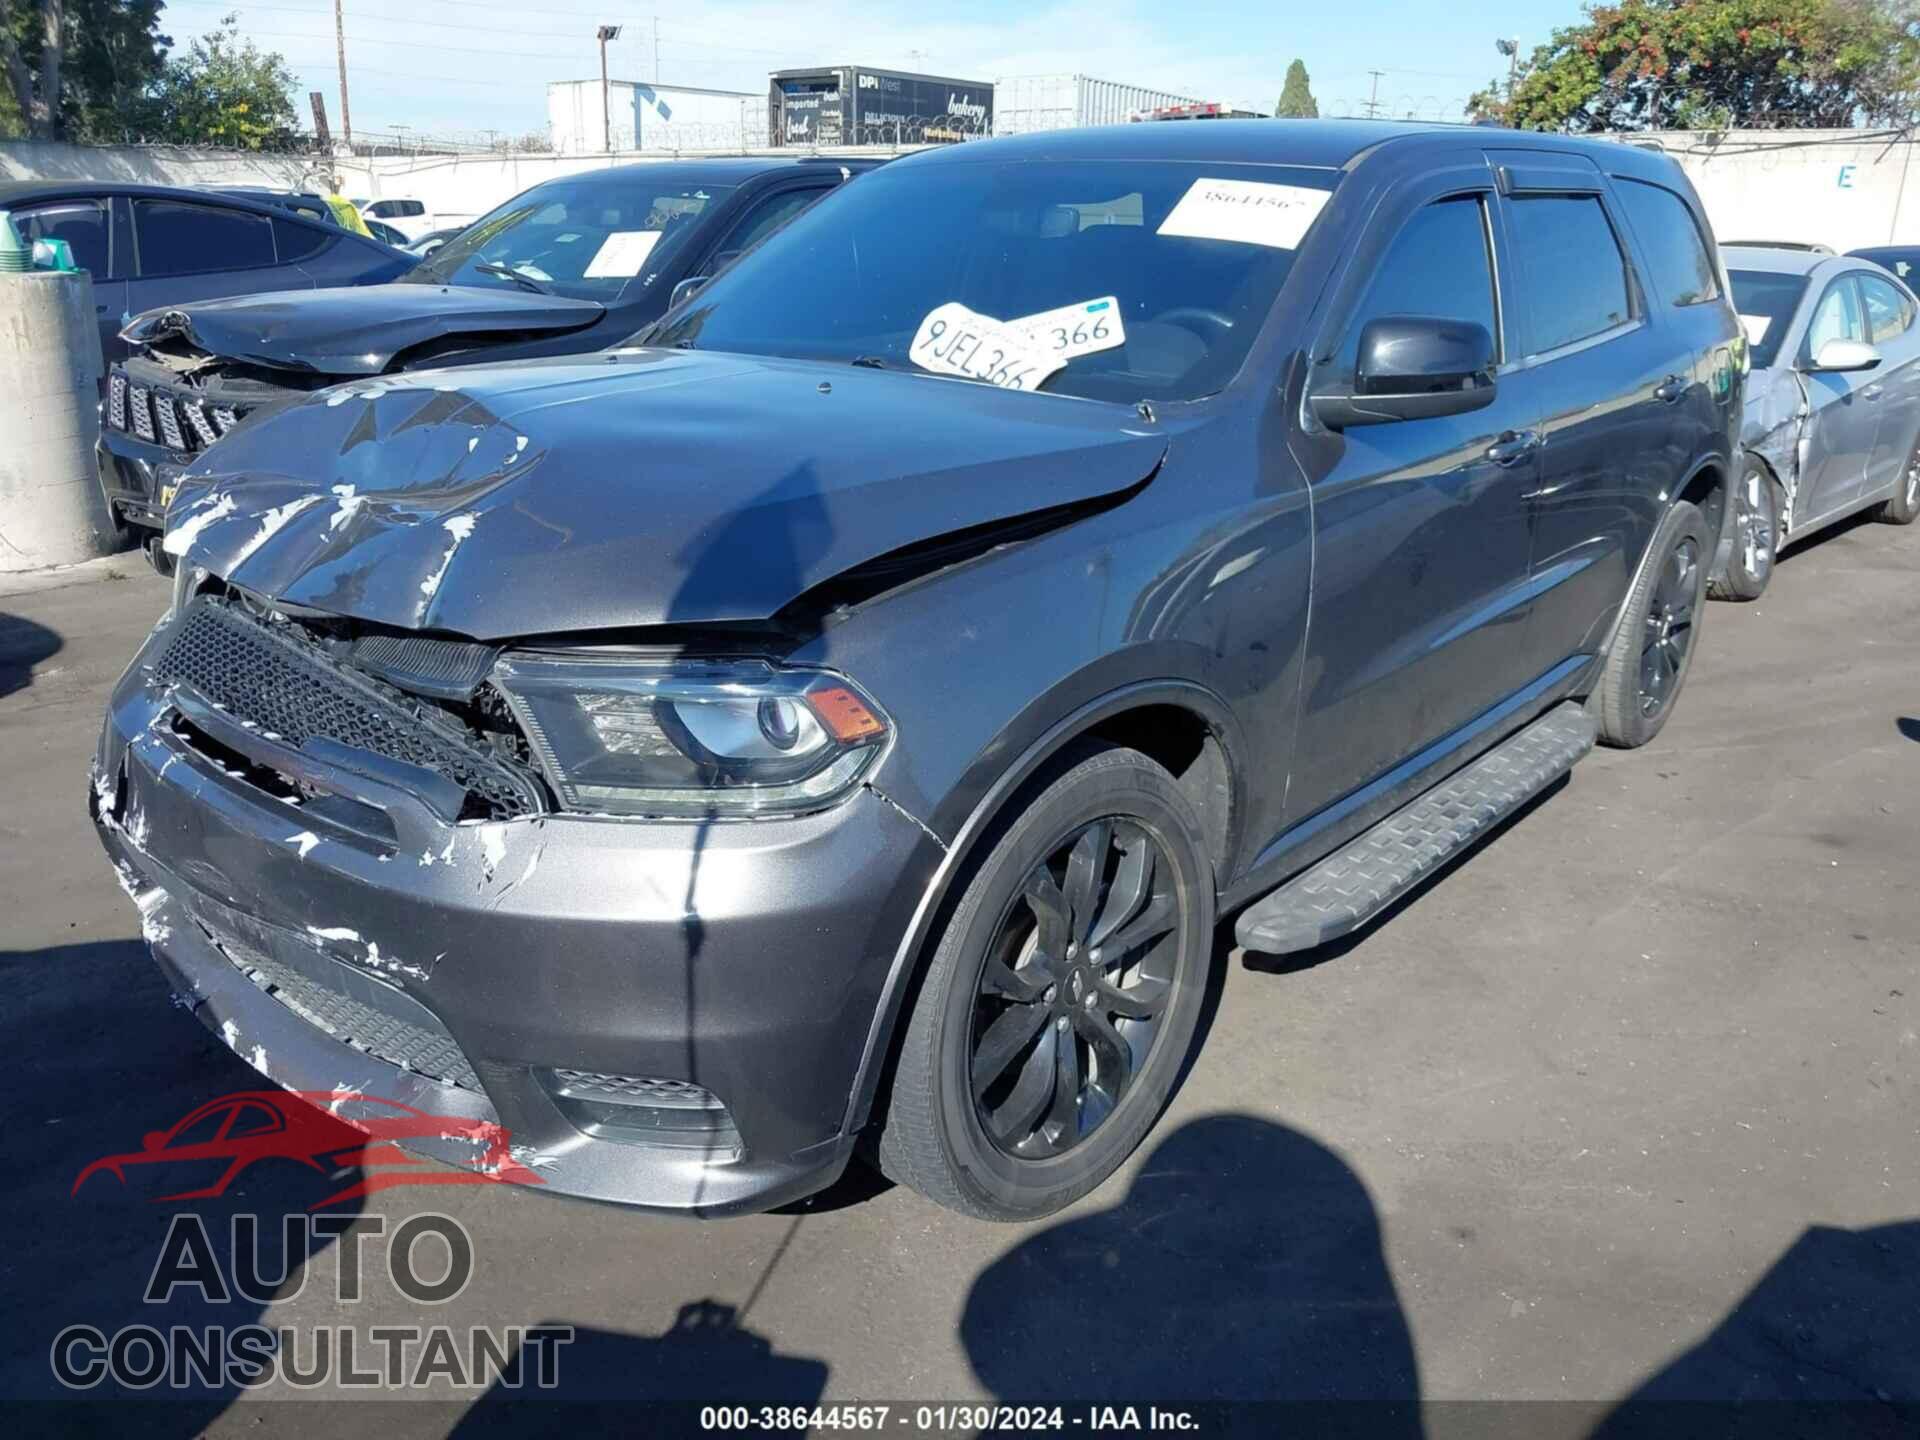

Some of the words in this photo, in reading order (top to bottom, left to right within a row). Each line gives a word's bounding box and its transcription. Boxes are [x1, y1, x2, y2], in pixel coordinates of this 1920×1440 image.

[858, 74, 879, 90] DPI
[947, 92, 986, 127] bakery
[1837, 165, 1857, 188] E
[1051, 315, 1110, 351] 366
[918, 319, 1037, 390] 9JEL366
